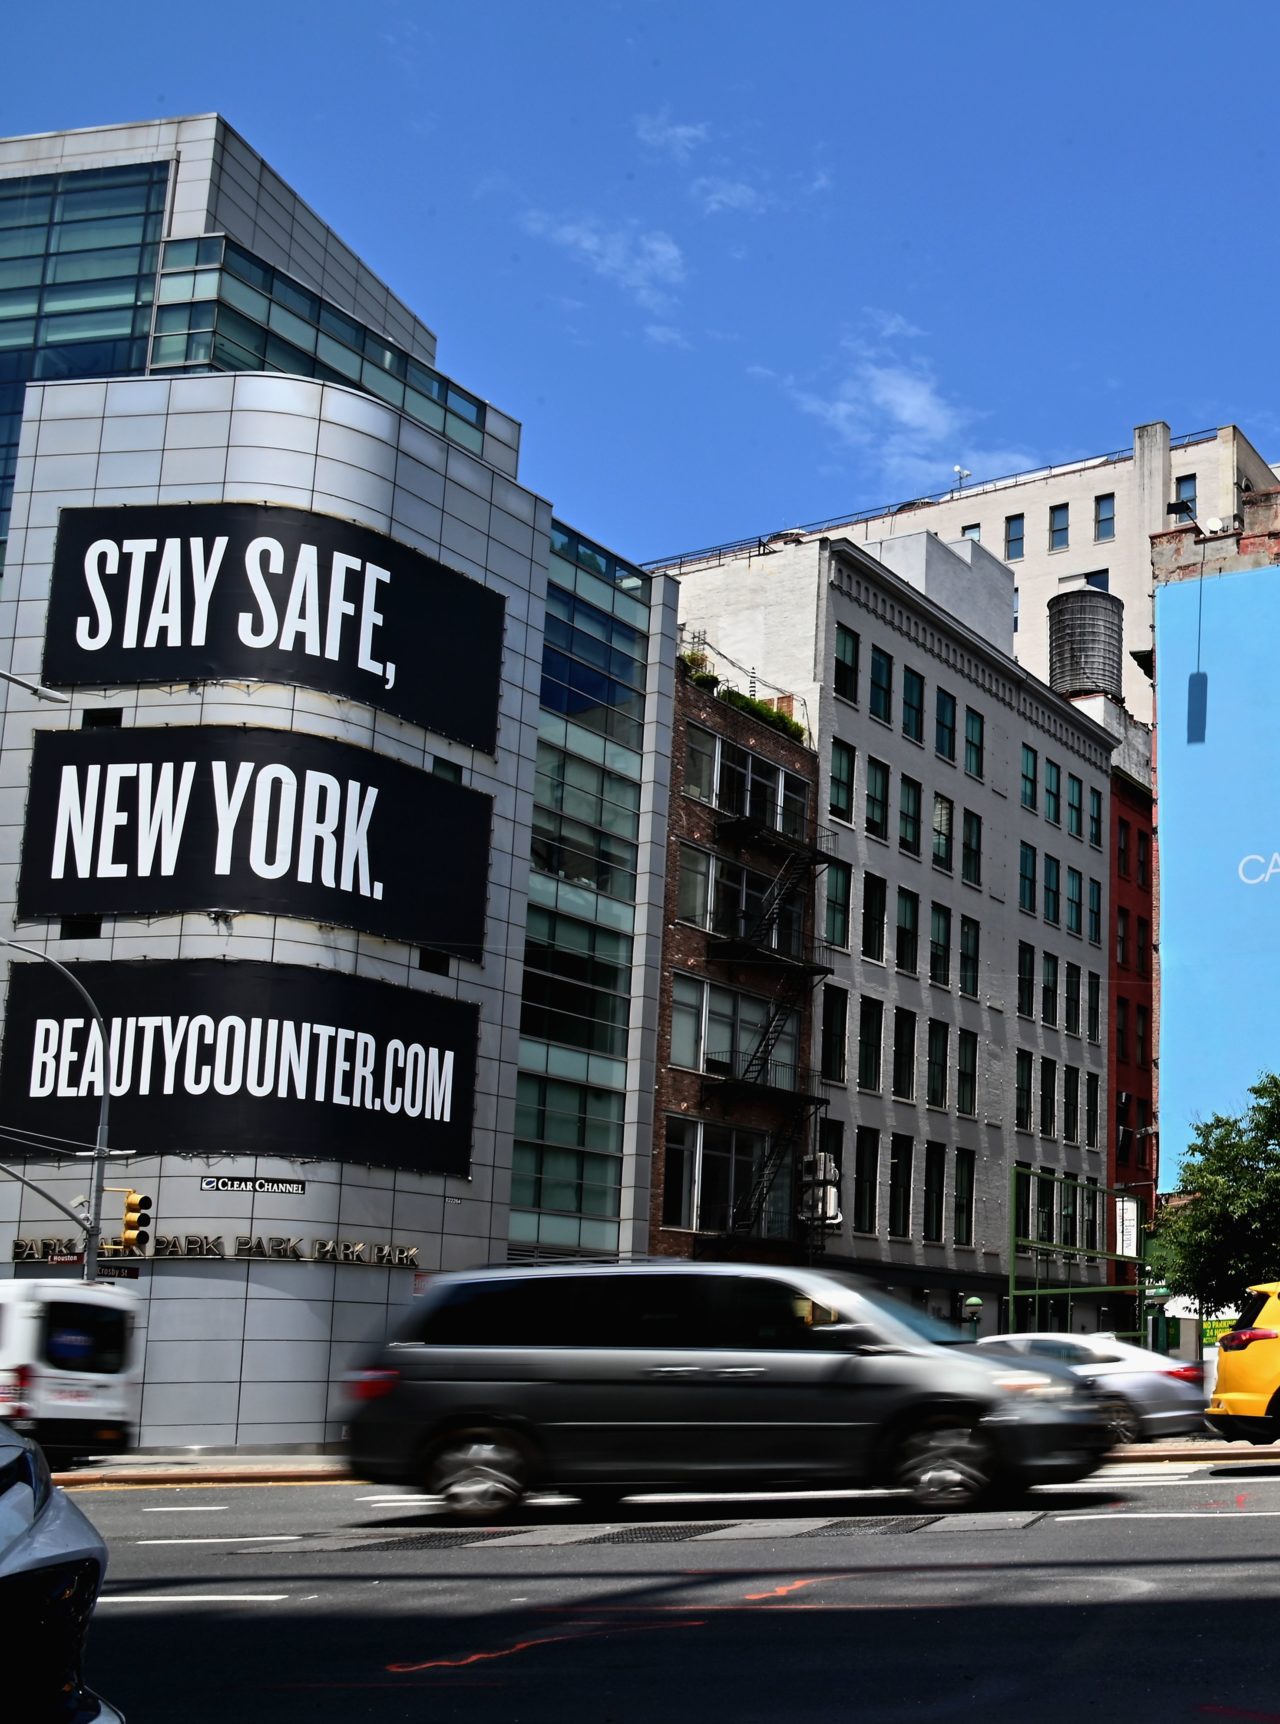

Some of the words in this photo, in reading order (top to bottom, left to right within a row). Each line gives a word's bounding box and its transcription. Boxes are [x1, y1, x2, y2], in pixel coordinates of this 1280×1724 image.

[76, 536, 229, 651] STAY
[237, 536, 396, 690] SAFE,
[51, 760, 196, 880] NEW
[211, 760, 384, 900] YORK.
[29, 1014, 455, 1122] BEAUTYCOUNTER.COM
[217, 1178, 253, 1191] CLEAR
[255, 1179, 304, 1194] CHANNEL
[13, 1238, 75, 1259] PARK
[155, 1235, 223, 1257] PARK
[235, 1236, 304, 1258] PARK
[315, 1239, 367, 1262] PARK
[374, 1244, 420, 1266] PARK
[53, 1254, 78, 1262] Houston
[97, 1266, 119, 1277] Crosby
[121, 1268, 128, 1277] St
